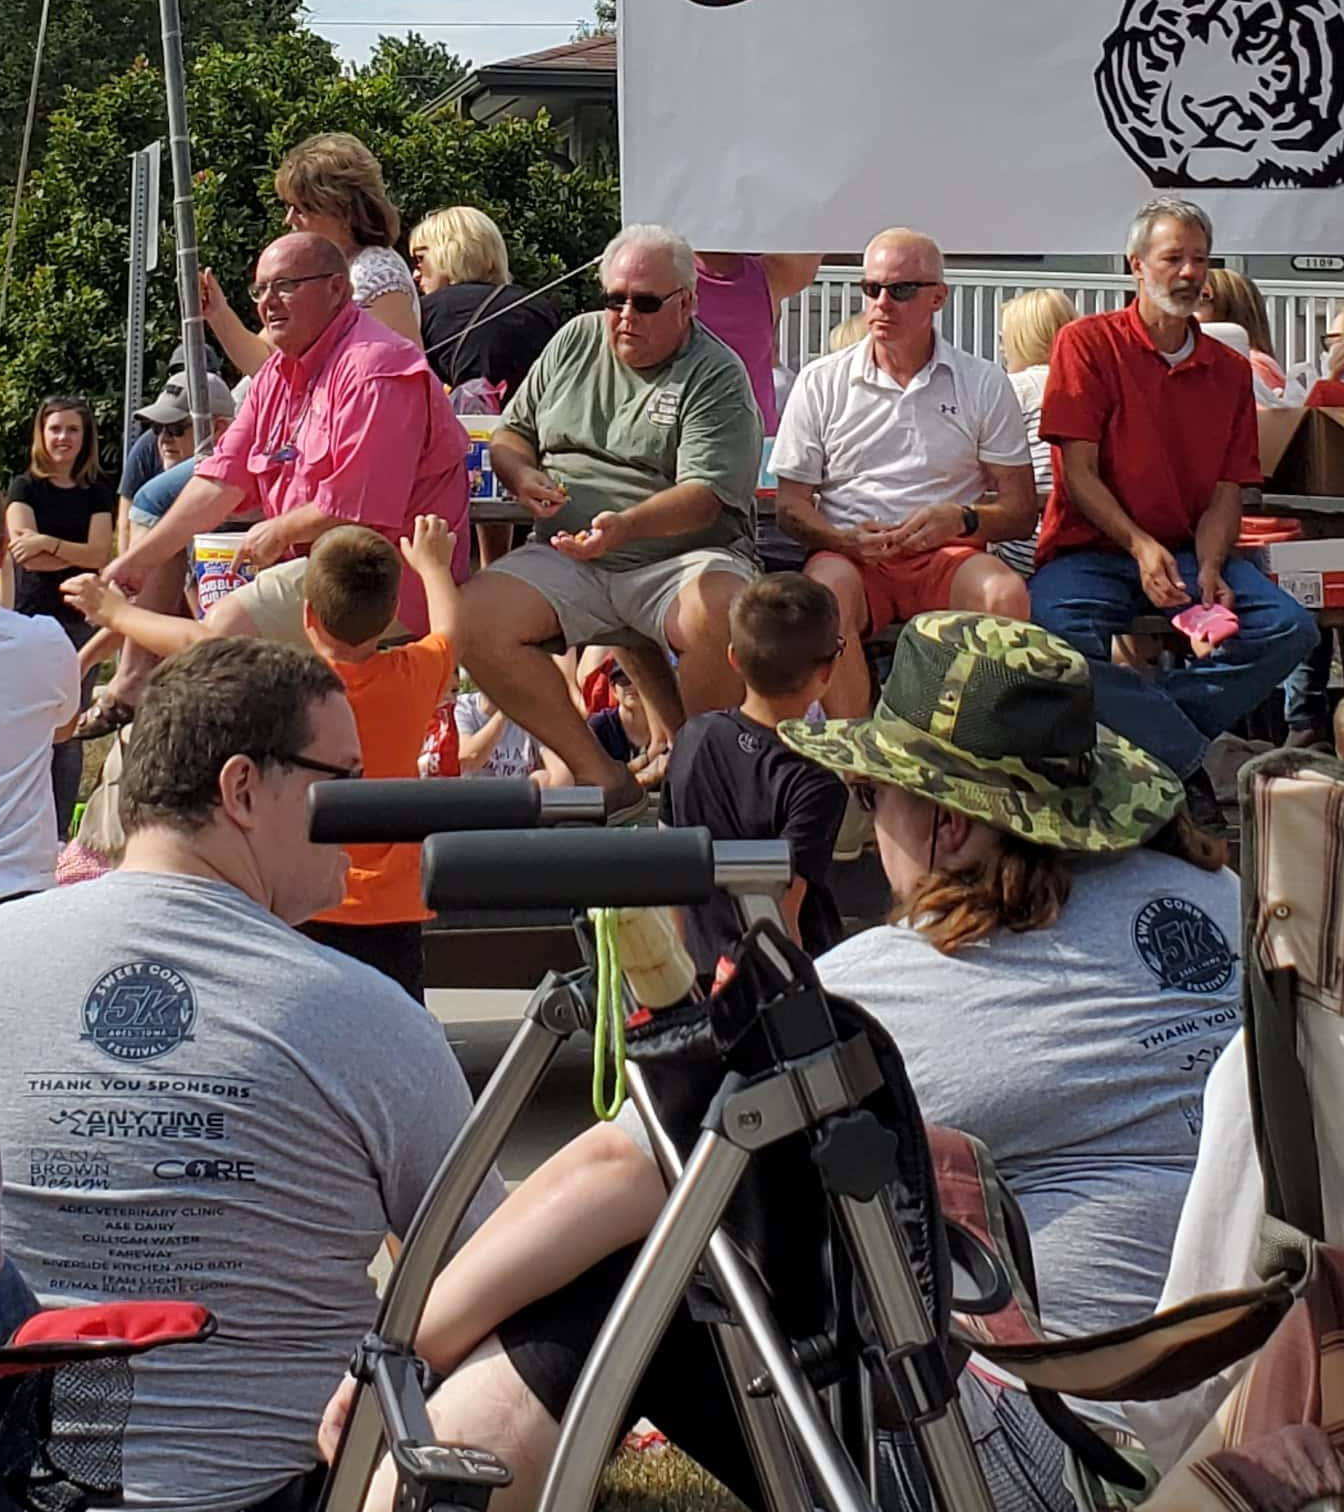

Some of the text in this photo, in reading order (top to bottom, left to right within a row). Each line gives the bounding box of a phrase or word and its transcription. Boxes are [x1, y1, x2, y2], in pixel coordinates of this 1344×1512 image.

[1136, 898, 1203, 945] SWEET CORN
[1153, 919, 1214, 966] 5K
[95, 963, 187, 997] SWEET CORN
[1138, 1007, 1237, 1049] THANK YOU
[107, 1041, 167, 1057] FESTIVAL
[28, 1079, 251, 1099] THANK YOU SPONSORS
[85, 1110, 225, 1128] ANYTIME
[88, 1126, 226, 1141] FITNESS
[30, 1147, 109, 1163] DANA
[30, 1163, 110, 1176] BROWN
[30, 1175, 110, 1194] Design
[94, 1206, 178, 1218] VETERINARY
[180, 1207, 225, 1218] CLINIC
[134, 1222, 176, 1232] DAIRY
[173, 1261, 205, 1271] AND
